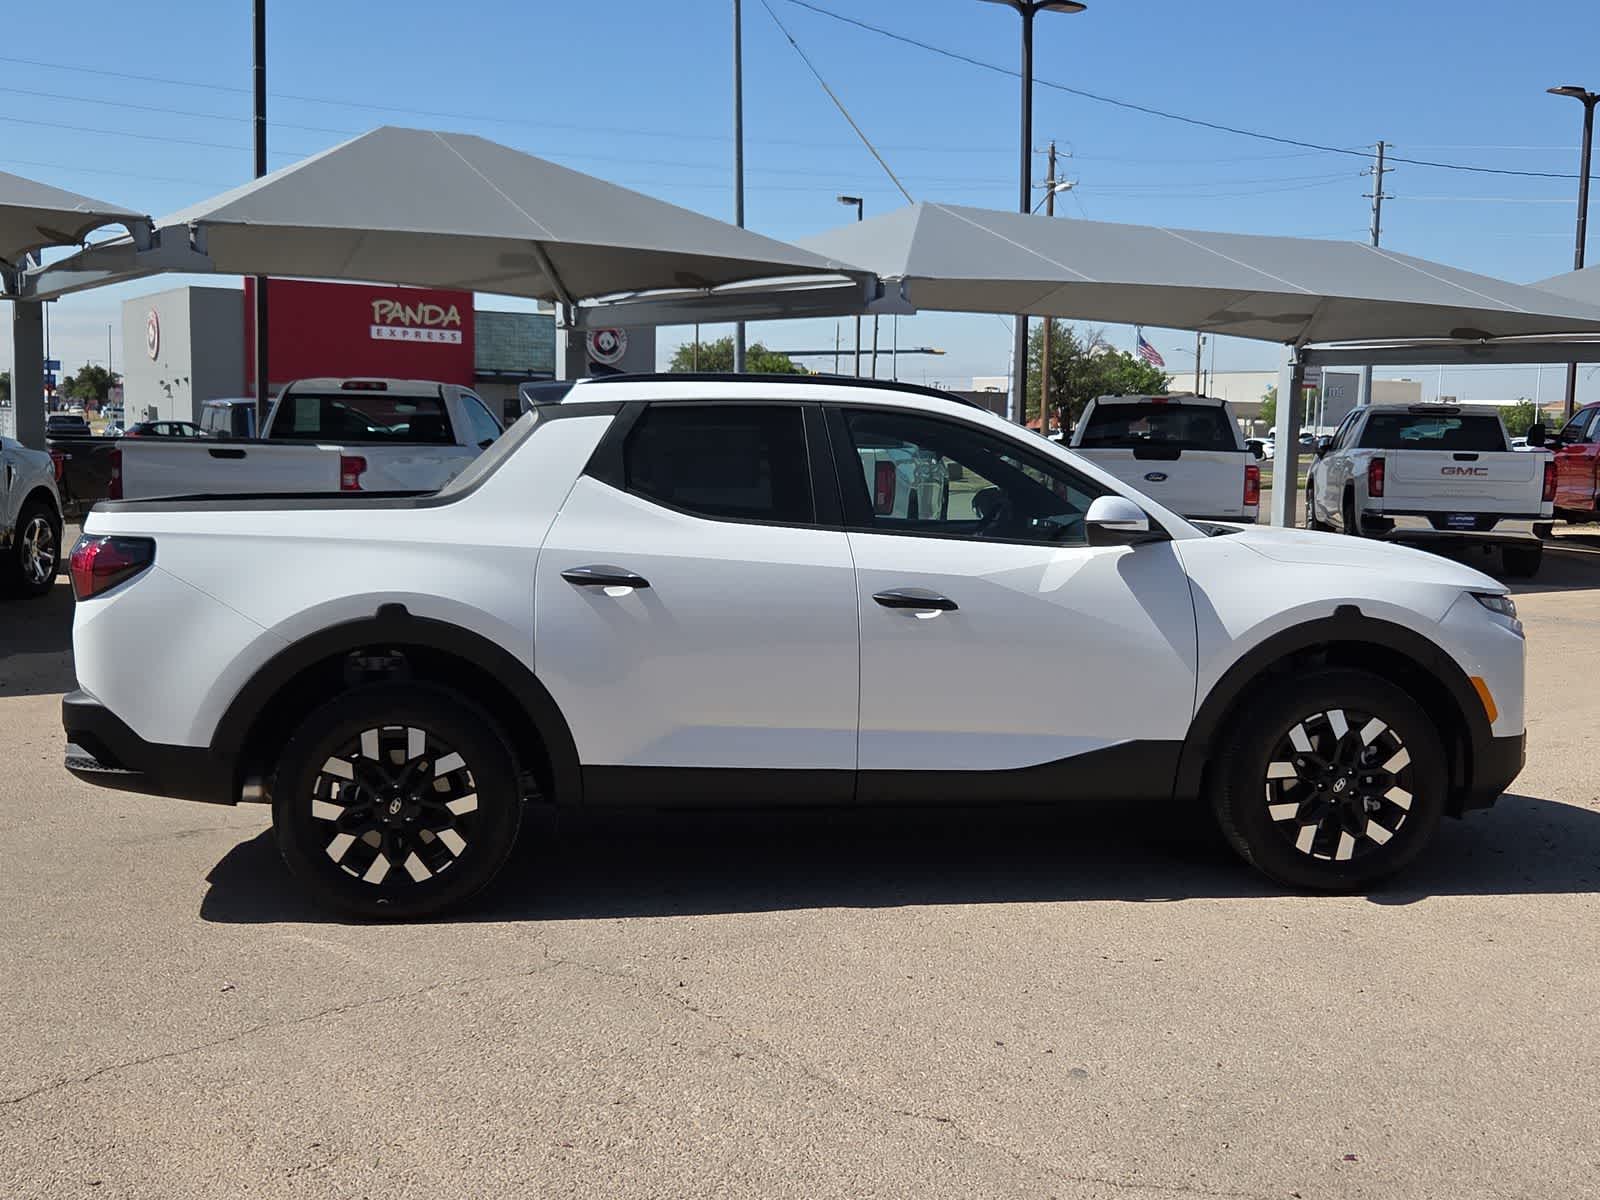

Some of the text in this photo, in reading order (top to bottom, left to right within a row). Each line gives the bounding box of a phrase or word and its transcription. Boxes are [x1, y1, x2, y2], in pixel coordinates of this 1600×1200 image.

[371, 299, 462, 327] PANDA
[375, 327, 458, 342] EXPRESS
[1441, 466, 1488, 476] GMC
